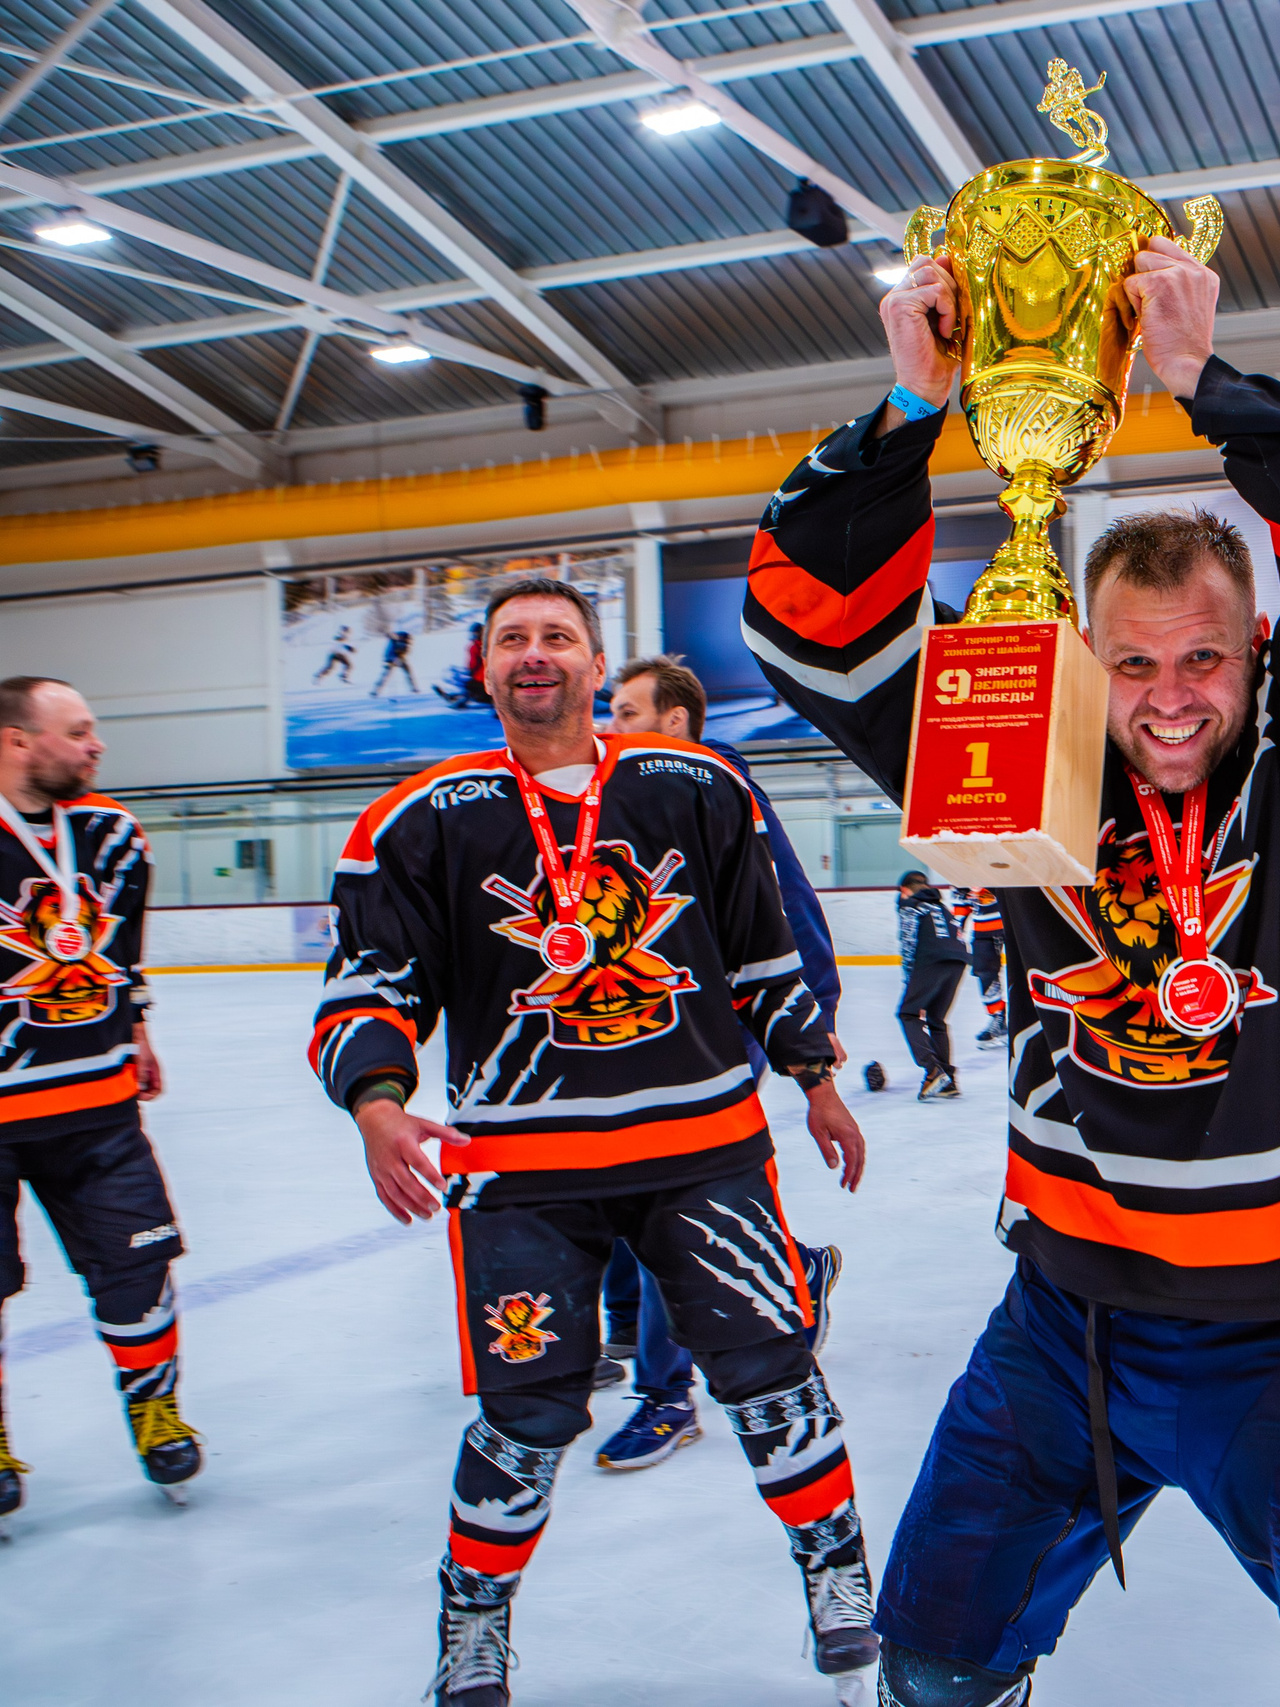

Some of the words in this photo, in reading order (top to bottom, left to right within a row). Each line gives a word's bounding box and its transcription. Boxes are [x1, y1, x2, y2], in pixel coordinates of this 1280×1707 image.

[964, 636, 1003, 645] ТУРНИР
[1005, 635, 1020, 643] ПО
[943, 648, 986, 657] ХОККЕЮ
[996, 643, 1041, 654] ШАЙБОЙ
[975, 665, 1037, 677] ЭНЕРГИЯ
[935, 668, 972, 705] 9
[973, 676, 1037, 691] ВЕЛИКОЙ
[972, 692, 1035, 704] ПОБЕДЫ
[965, 742, 990, 777] 1
